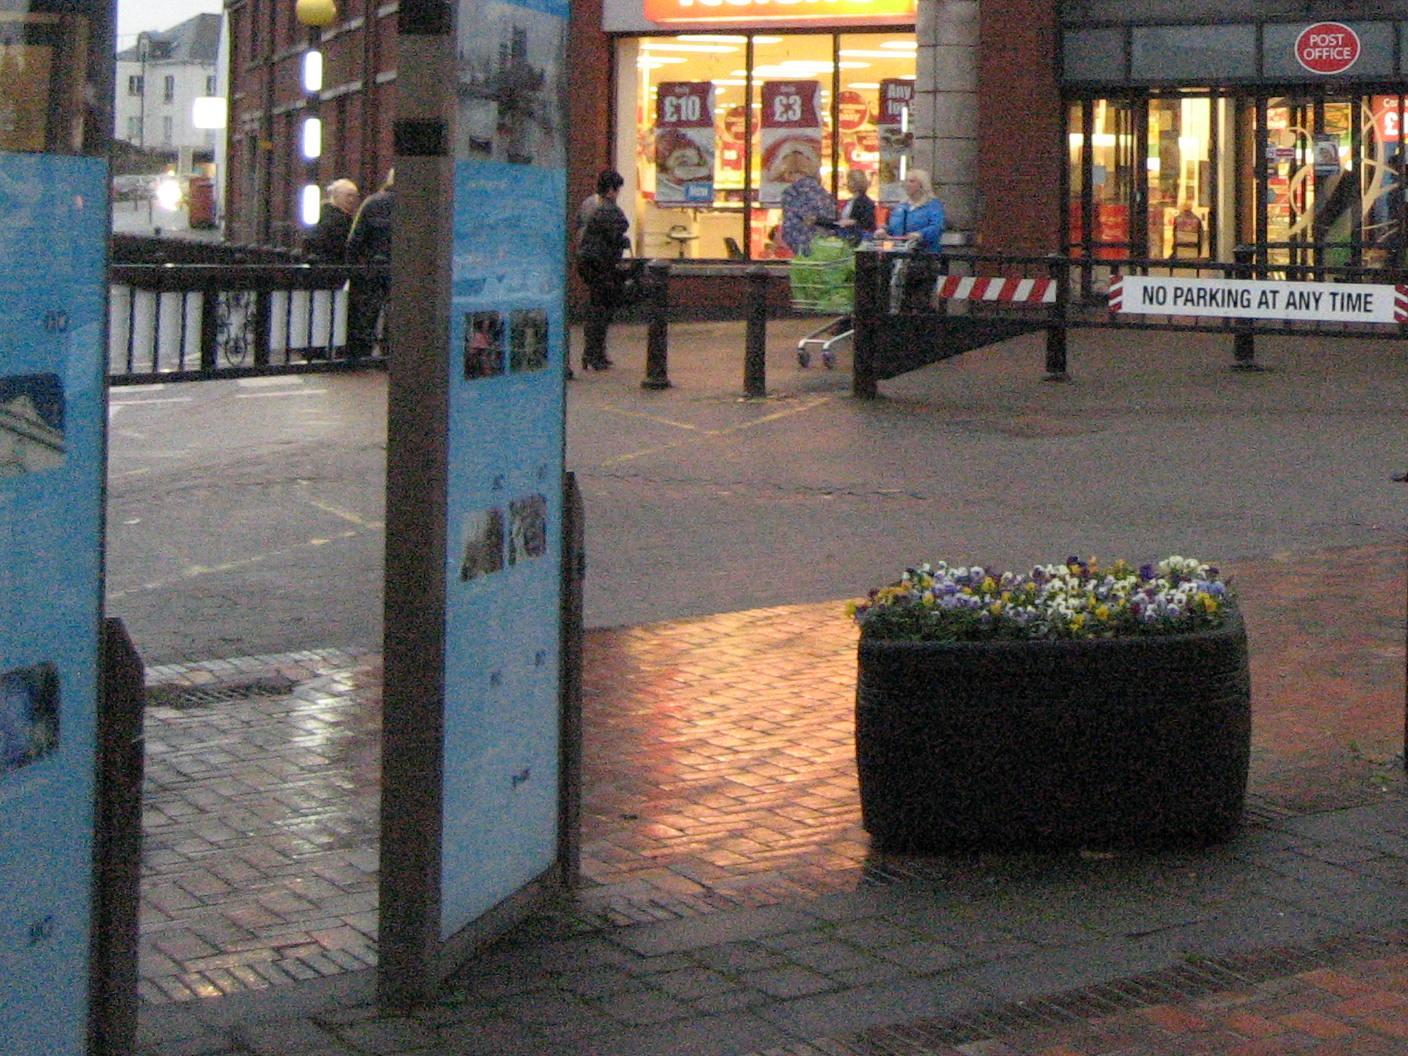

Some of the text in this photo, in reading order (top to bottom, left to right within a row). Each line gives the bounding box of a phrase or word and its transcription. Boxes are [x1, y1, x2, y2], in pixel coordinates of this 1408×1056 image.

[1309, 33, 1345, 47] POST
[1303, 47, 1352, 61] OFFICE
[664, 95, 701, 122] £10
[774, 95, 802, 121] £3
[1142, 285, 1374, 312] NO PARKING AT ANY TIME
